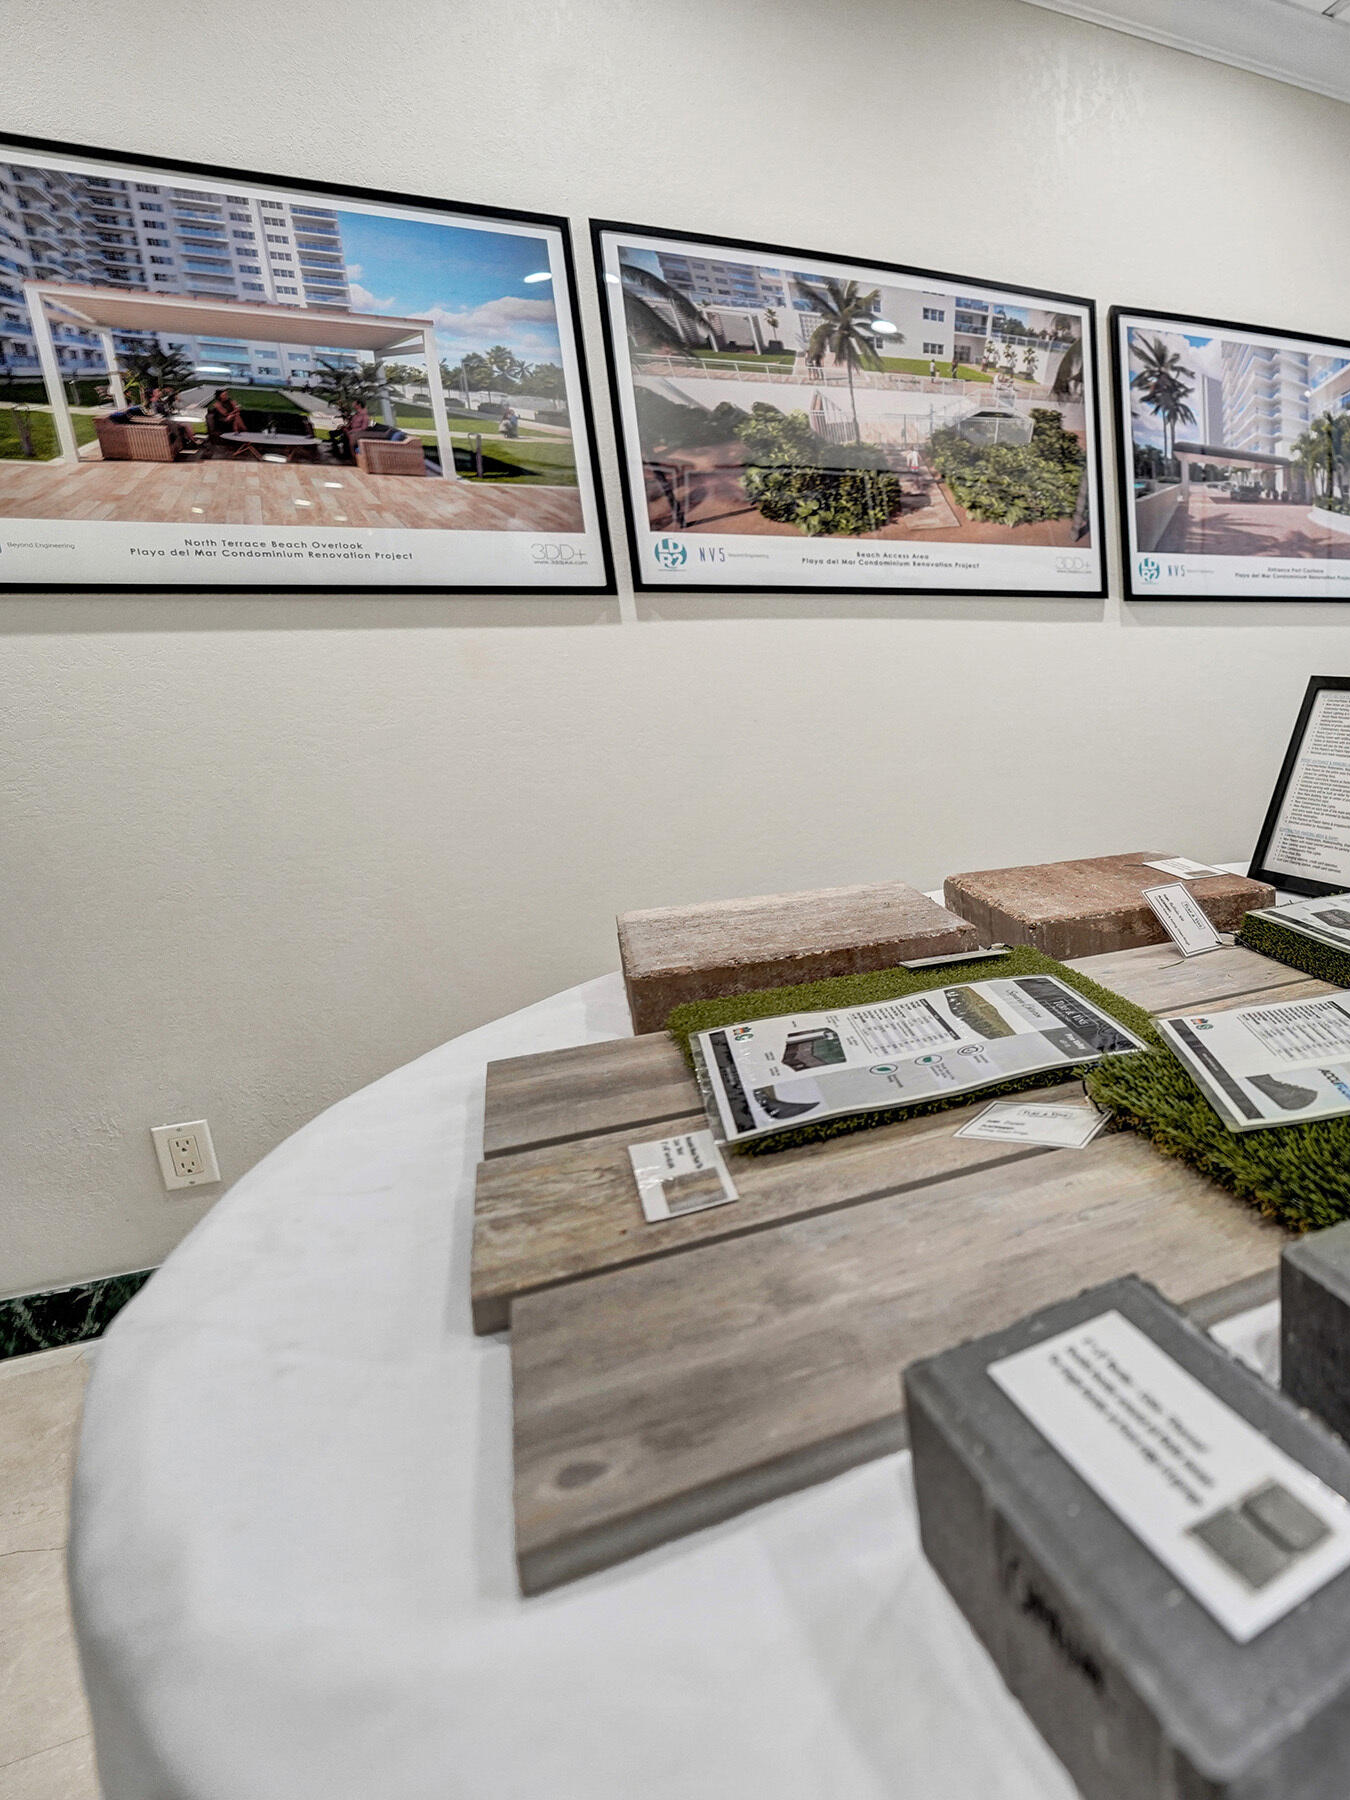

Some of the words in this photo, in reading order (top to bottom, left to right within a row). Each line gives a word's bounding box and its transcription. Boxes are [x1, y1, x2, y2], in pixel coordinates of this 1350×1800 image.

[184, 538, 217, 547] North
[222, 539, 266, 548] Terrace
[271, 540, 307, 549] Beach
[312, 541, 363, 550] Overlook
[530, 543, 586, 560] 3DD+
[130, 548, 165, 557] Playa
[170, 548, 190, 557] del
[194, 549, 218, 557] Mar
[222, 549, 303, 558] Condominium
[308, 551, 370, 559] Renovation
[375, 552, 413, 561] Project
[1054, 1000, 1070, 1011] TURF
[1073, 1013, 1088, 1025] VINE
